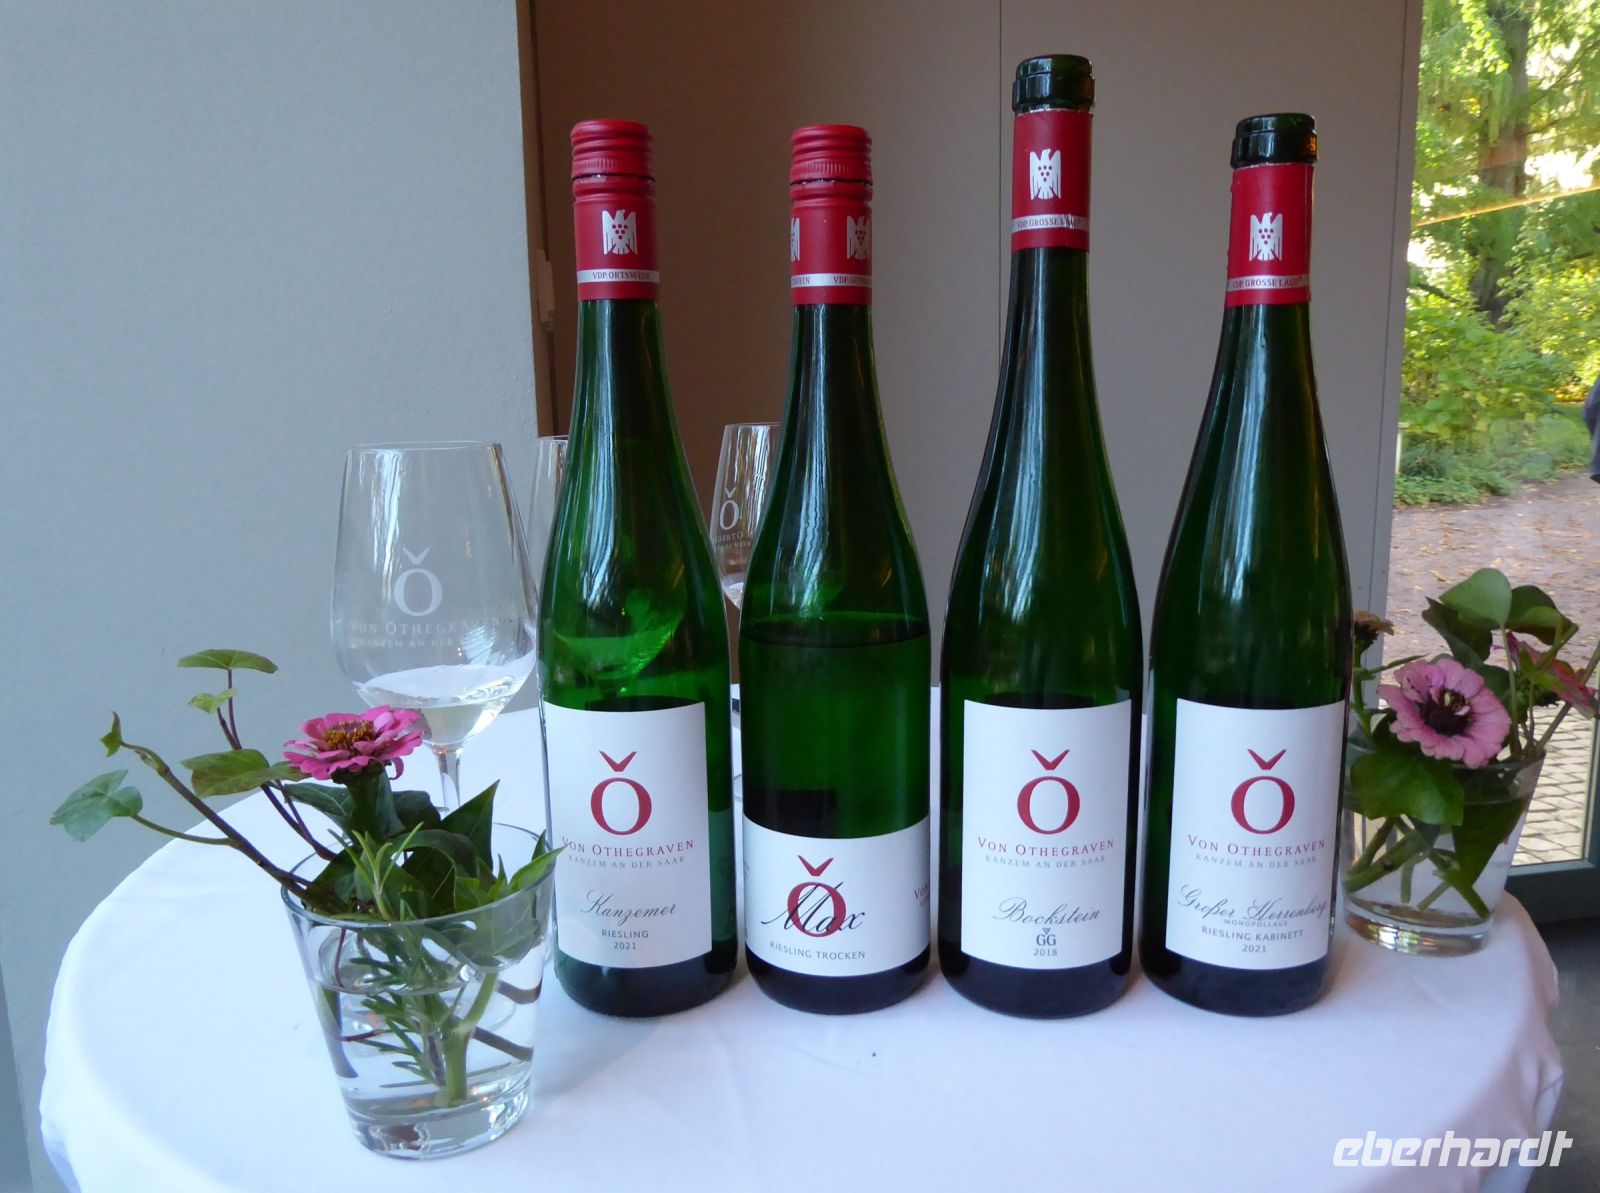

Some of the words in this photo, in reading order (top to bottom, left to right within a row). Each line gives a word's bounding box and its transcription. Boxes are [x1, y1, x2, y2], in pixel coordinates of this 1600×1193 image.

[592, 839, 694, 857] OTHEGRAVEN
[977, 836, 1007, 853] VON
[1015, 839, 1114, 857] OTHEGRAVEN
[1188, 835, 1219, 852] VON
[1227, 840, 1325, 857] OTHEGRAVEN
[612, 861, 626, 869] AN
[631, 860, 652, 868] DER
[657, 856, 685, 867] SAAR
[985, 855, 1030, 868] KANZEM
[1035, 861, 1050, 869] AN
[1056, 859, 1076, 868] DER
[1081, 855, 1106, 866] SAAR
[1195, 853, 1243, 868] KANZEM
[1248, 861, 1263, 869] AN
[1269, 860, 1289, 869] DER
[580, 889, 676, 926] Kanzemer
[761, 881, 866, 933] Max
[1177, 884, 1235, 918] Großer
[1243, 897, 1328, 921] Herrenberg
[992, 896, 1101, 926] Bockstein
[601, 929, 649, 939] RIESLING
[1036, 934, 1057, 946] GG
[1201, 925, 1251, 941] RIESLING
[1255, 929, 1304, 941] KABINETT
[614, 941, 637, 950] 2021
[769, 941, 812, 959] RIESLING
[816, 950, 866, 960] TROCKEN
[1033, 948, 1058, 956] 2018
[1242, 944, 1266, 953] 2021
